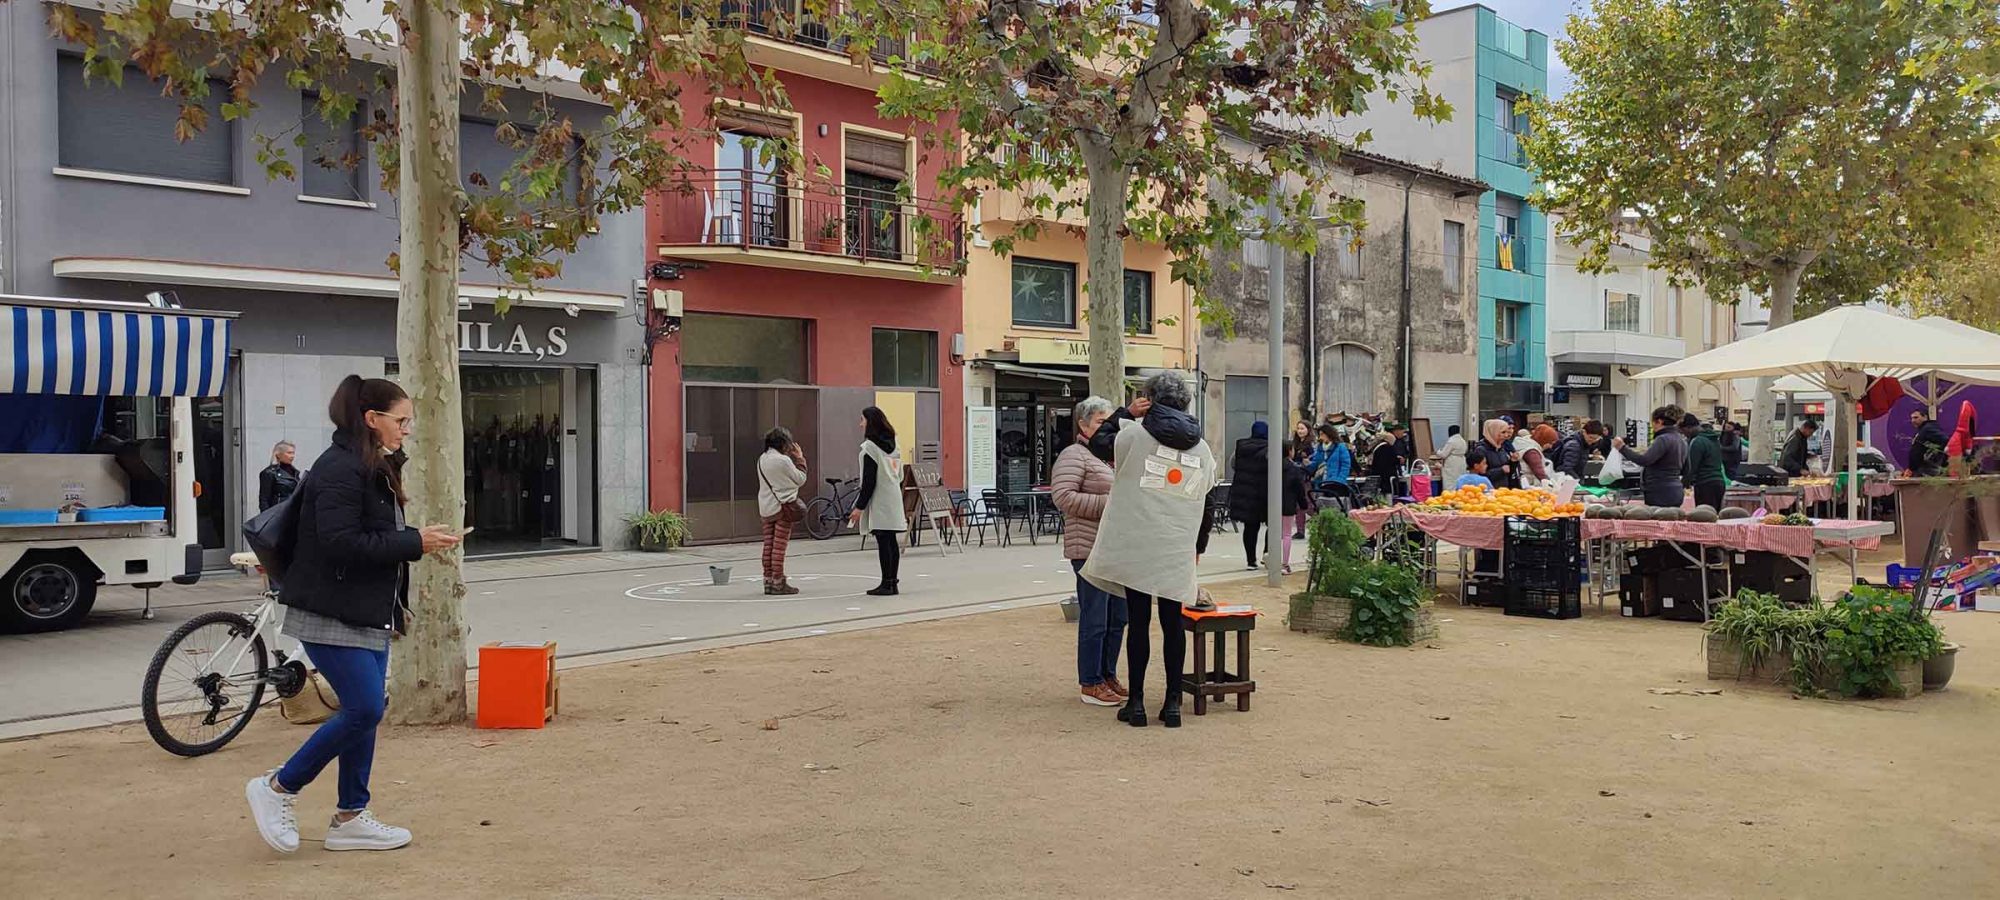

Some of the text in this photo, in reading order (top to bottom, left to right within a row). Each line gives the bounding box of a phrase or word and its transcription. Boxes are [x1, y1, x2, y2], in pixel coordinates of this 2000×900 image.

[296, 335, 306, 348] 11
[458, 321, 568, 362] ILA,S
[1069, 343, 1090, 356] MA
[1566, 374, 1603, 385] MANHATTAN
[1037, 430, 1045, 485] MAGRIL
